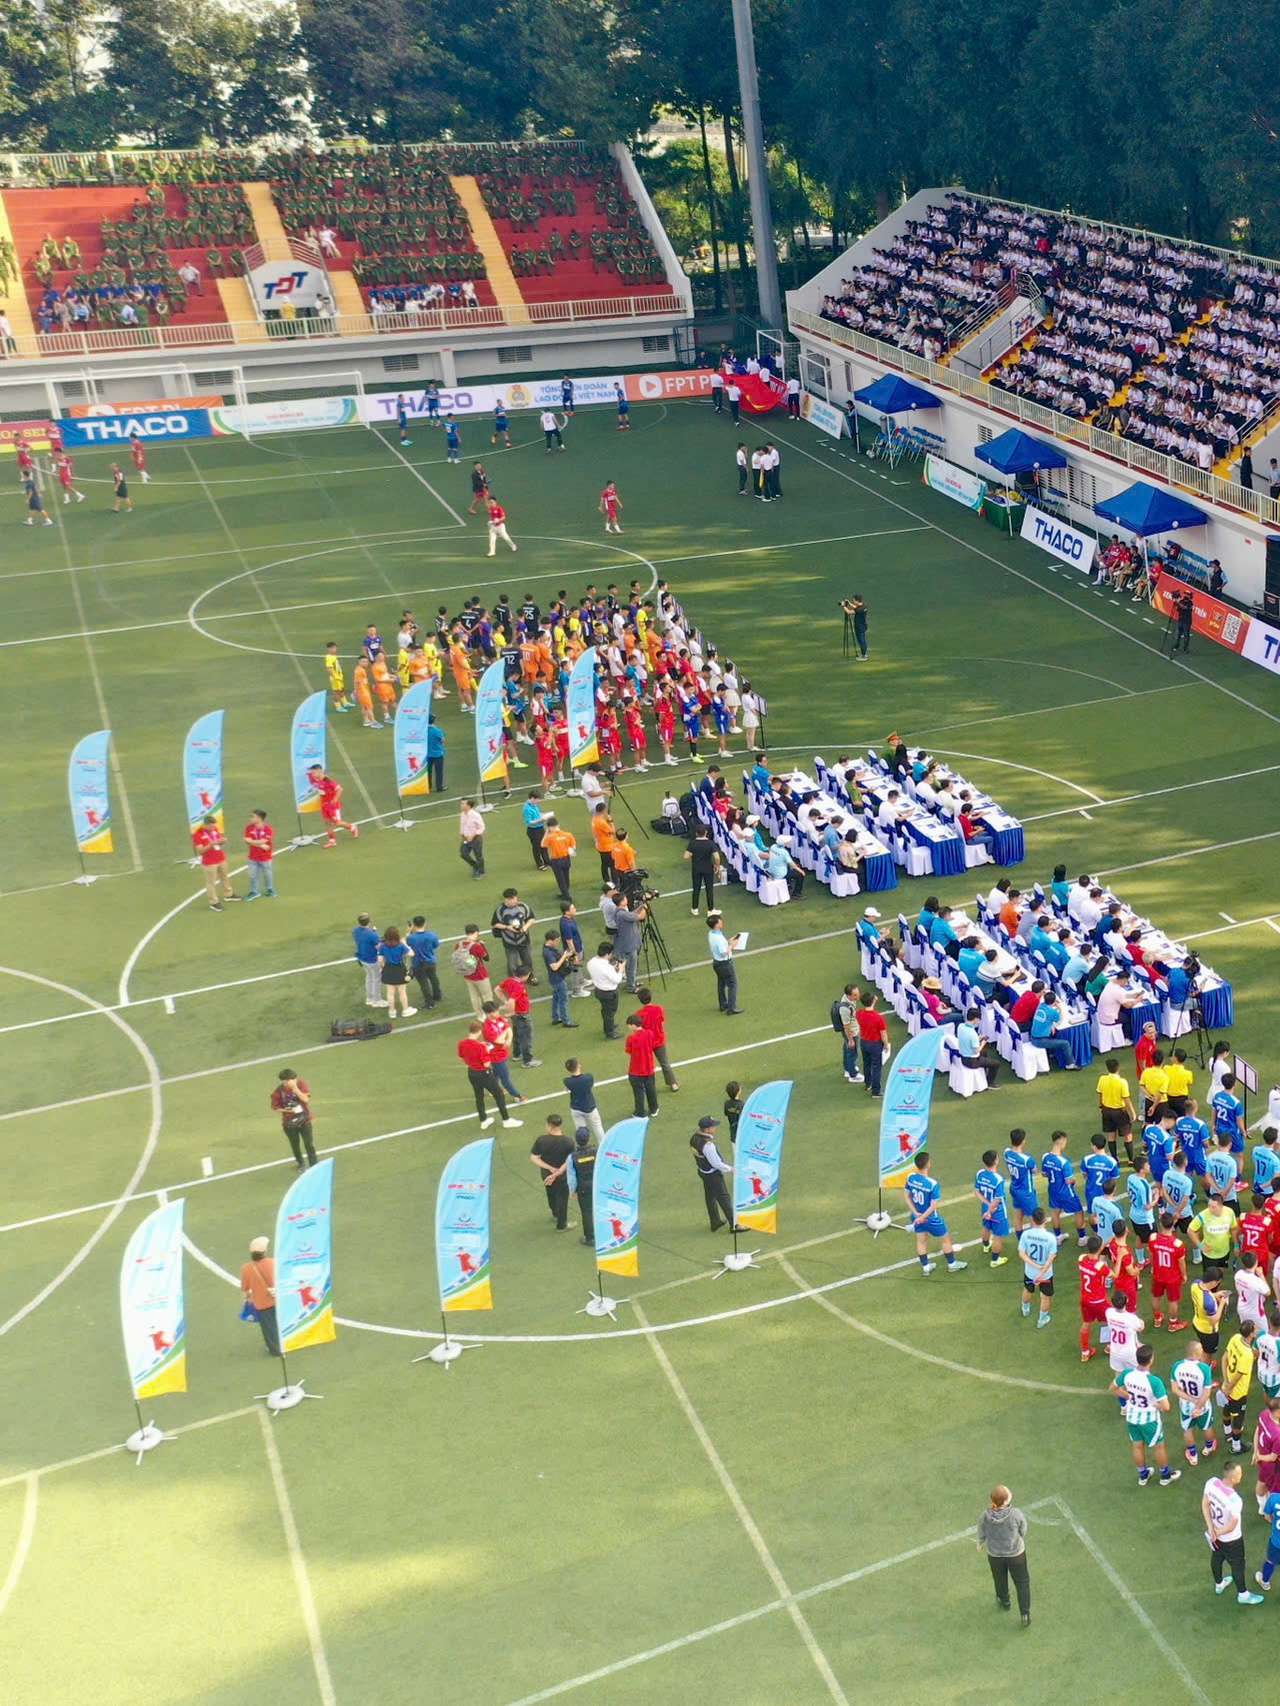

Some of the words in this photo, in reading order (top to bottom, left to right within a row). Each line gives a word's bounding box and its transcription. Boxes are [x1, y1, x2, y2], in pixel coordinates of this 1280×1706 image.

[664, 375, 695, 393] FPT
[77, 415, 189, 440] THACO
[1034, 517, 1083, 560] THACO
[1256, 1159, 1267, 1176] 17
[1096, 1171, 1103, 1186] 2
[911, 1188, 925, 1206] 30
[1098, 1213, 1106, 1229] 3
[1245, 1229, 1260, 1247] 12
[1029, 1243, 1043, 1261] 21
[1158, 1250, 1171, 1268] 10
[1083, 1274, 1092, 1293] 2
[1111, 1328, 1127, 1345] 20
